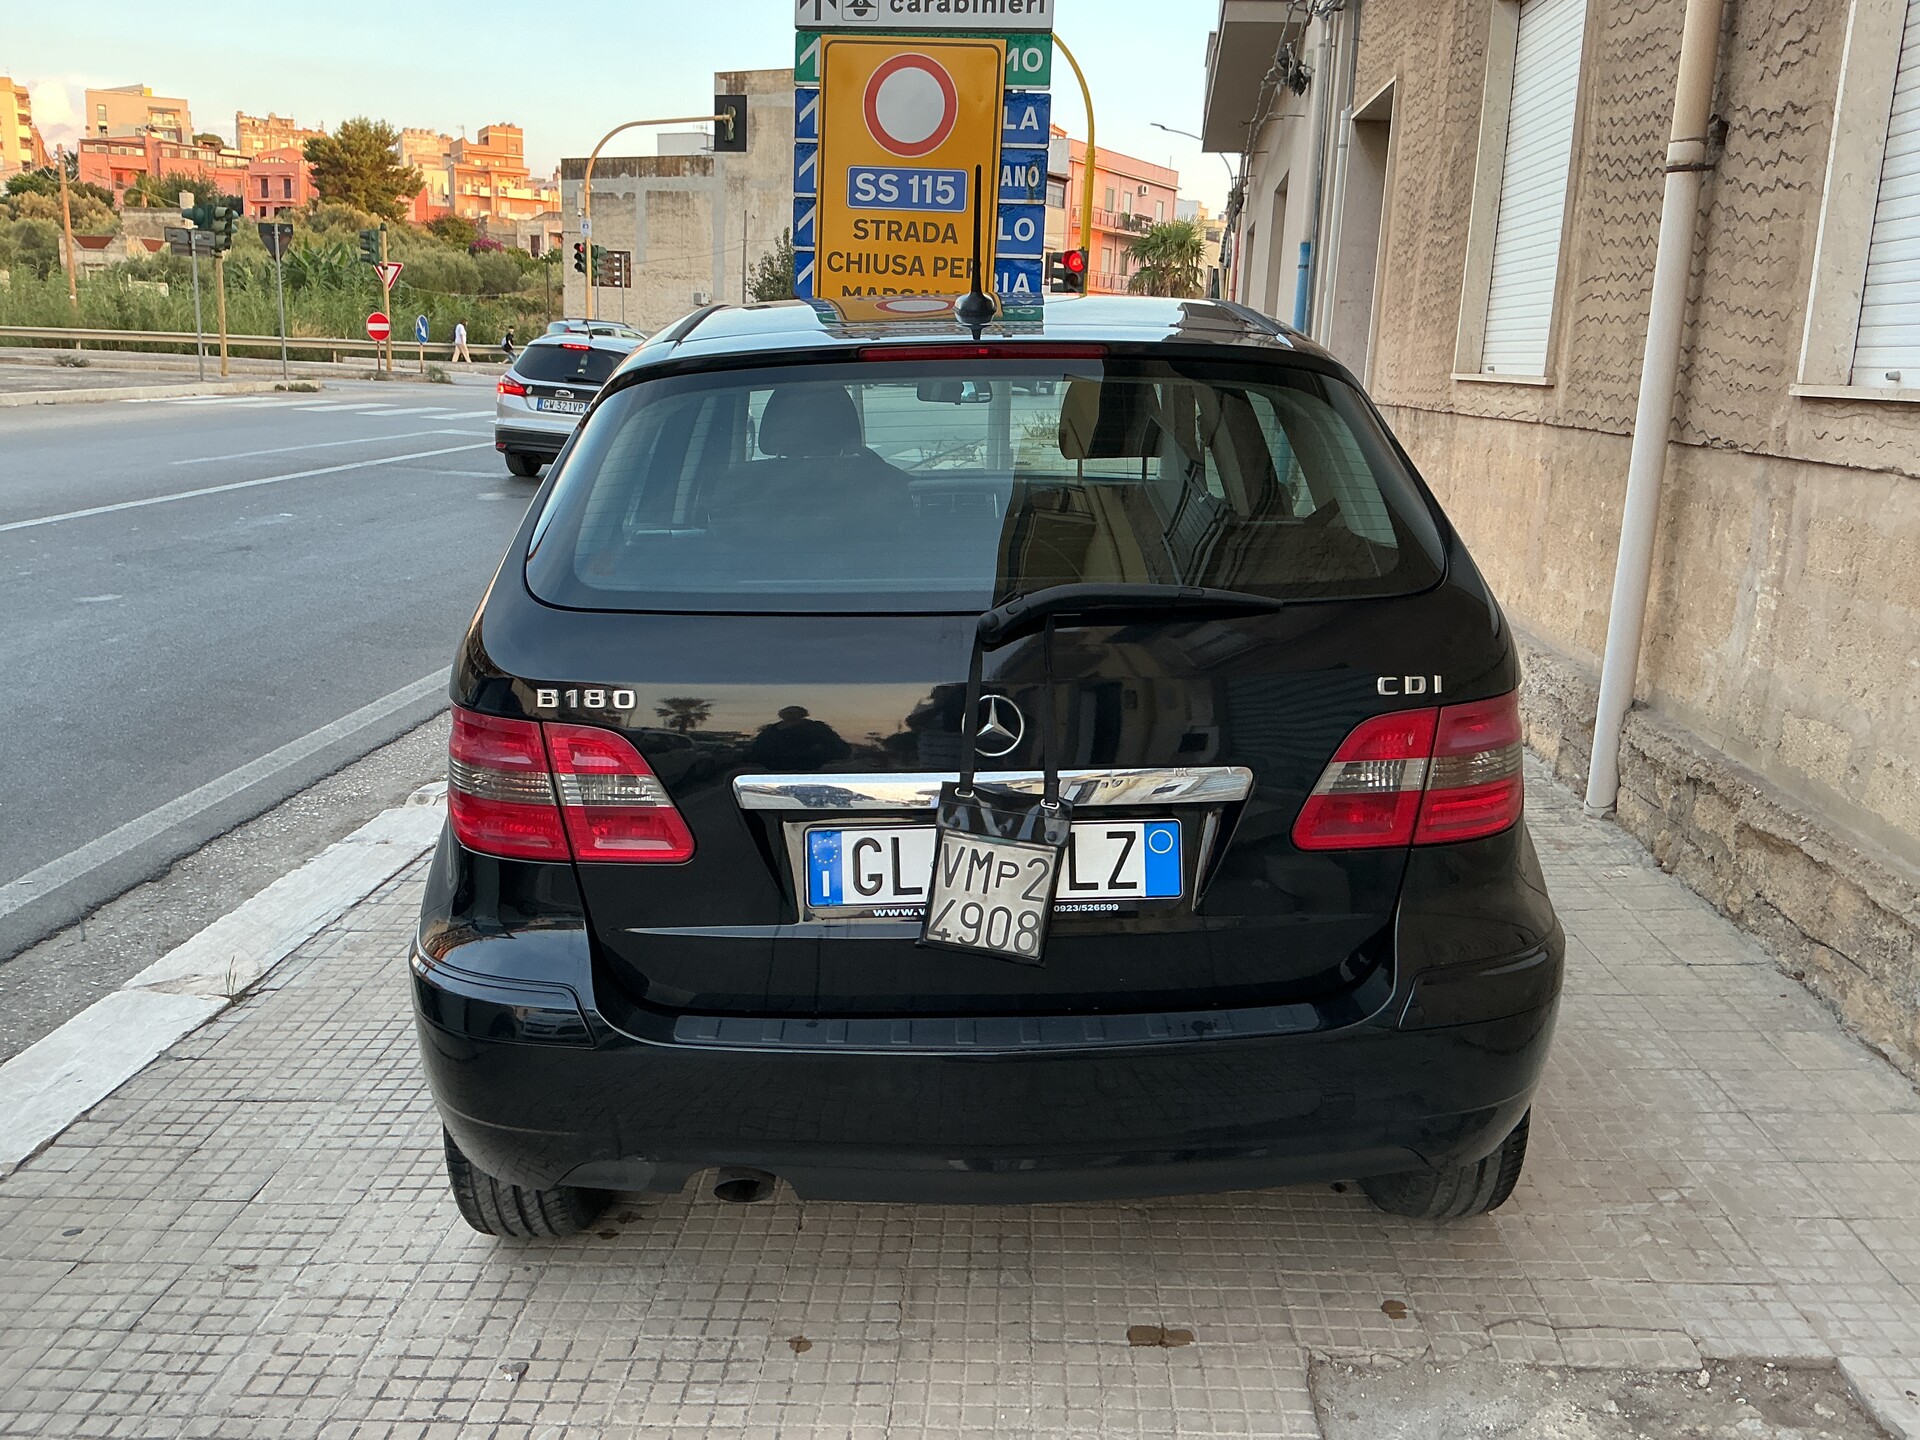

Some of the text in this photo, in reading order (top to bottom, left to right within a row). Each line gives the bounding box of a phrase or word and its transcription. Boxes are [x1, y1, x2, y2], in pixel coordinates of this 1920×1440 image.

[855, 173, 956, 205] SS 115
[852, 218, 959, 245] STRADA
[826, 251, 926, 277] CHIUSA
[1376, 674, 1443, 696] CDI
[536, 688, 637, 709] B180
[1053, 903, 1119, 912] 0923/526599
[928, 899, 1041, 955] 4908
